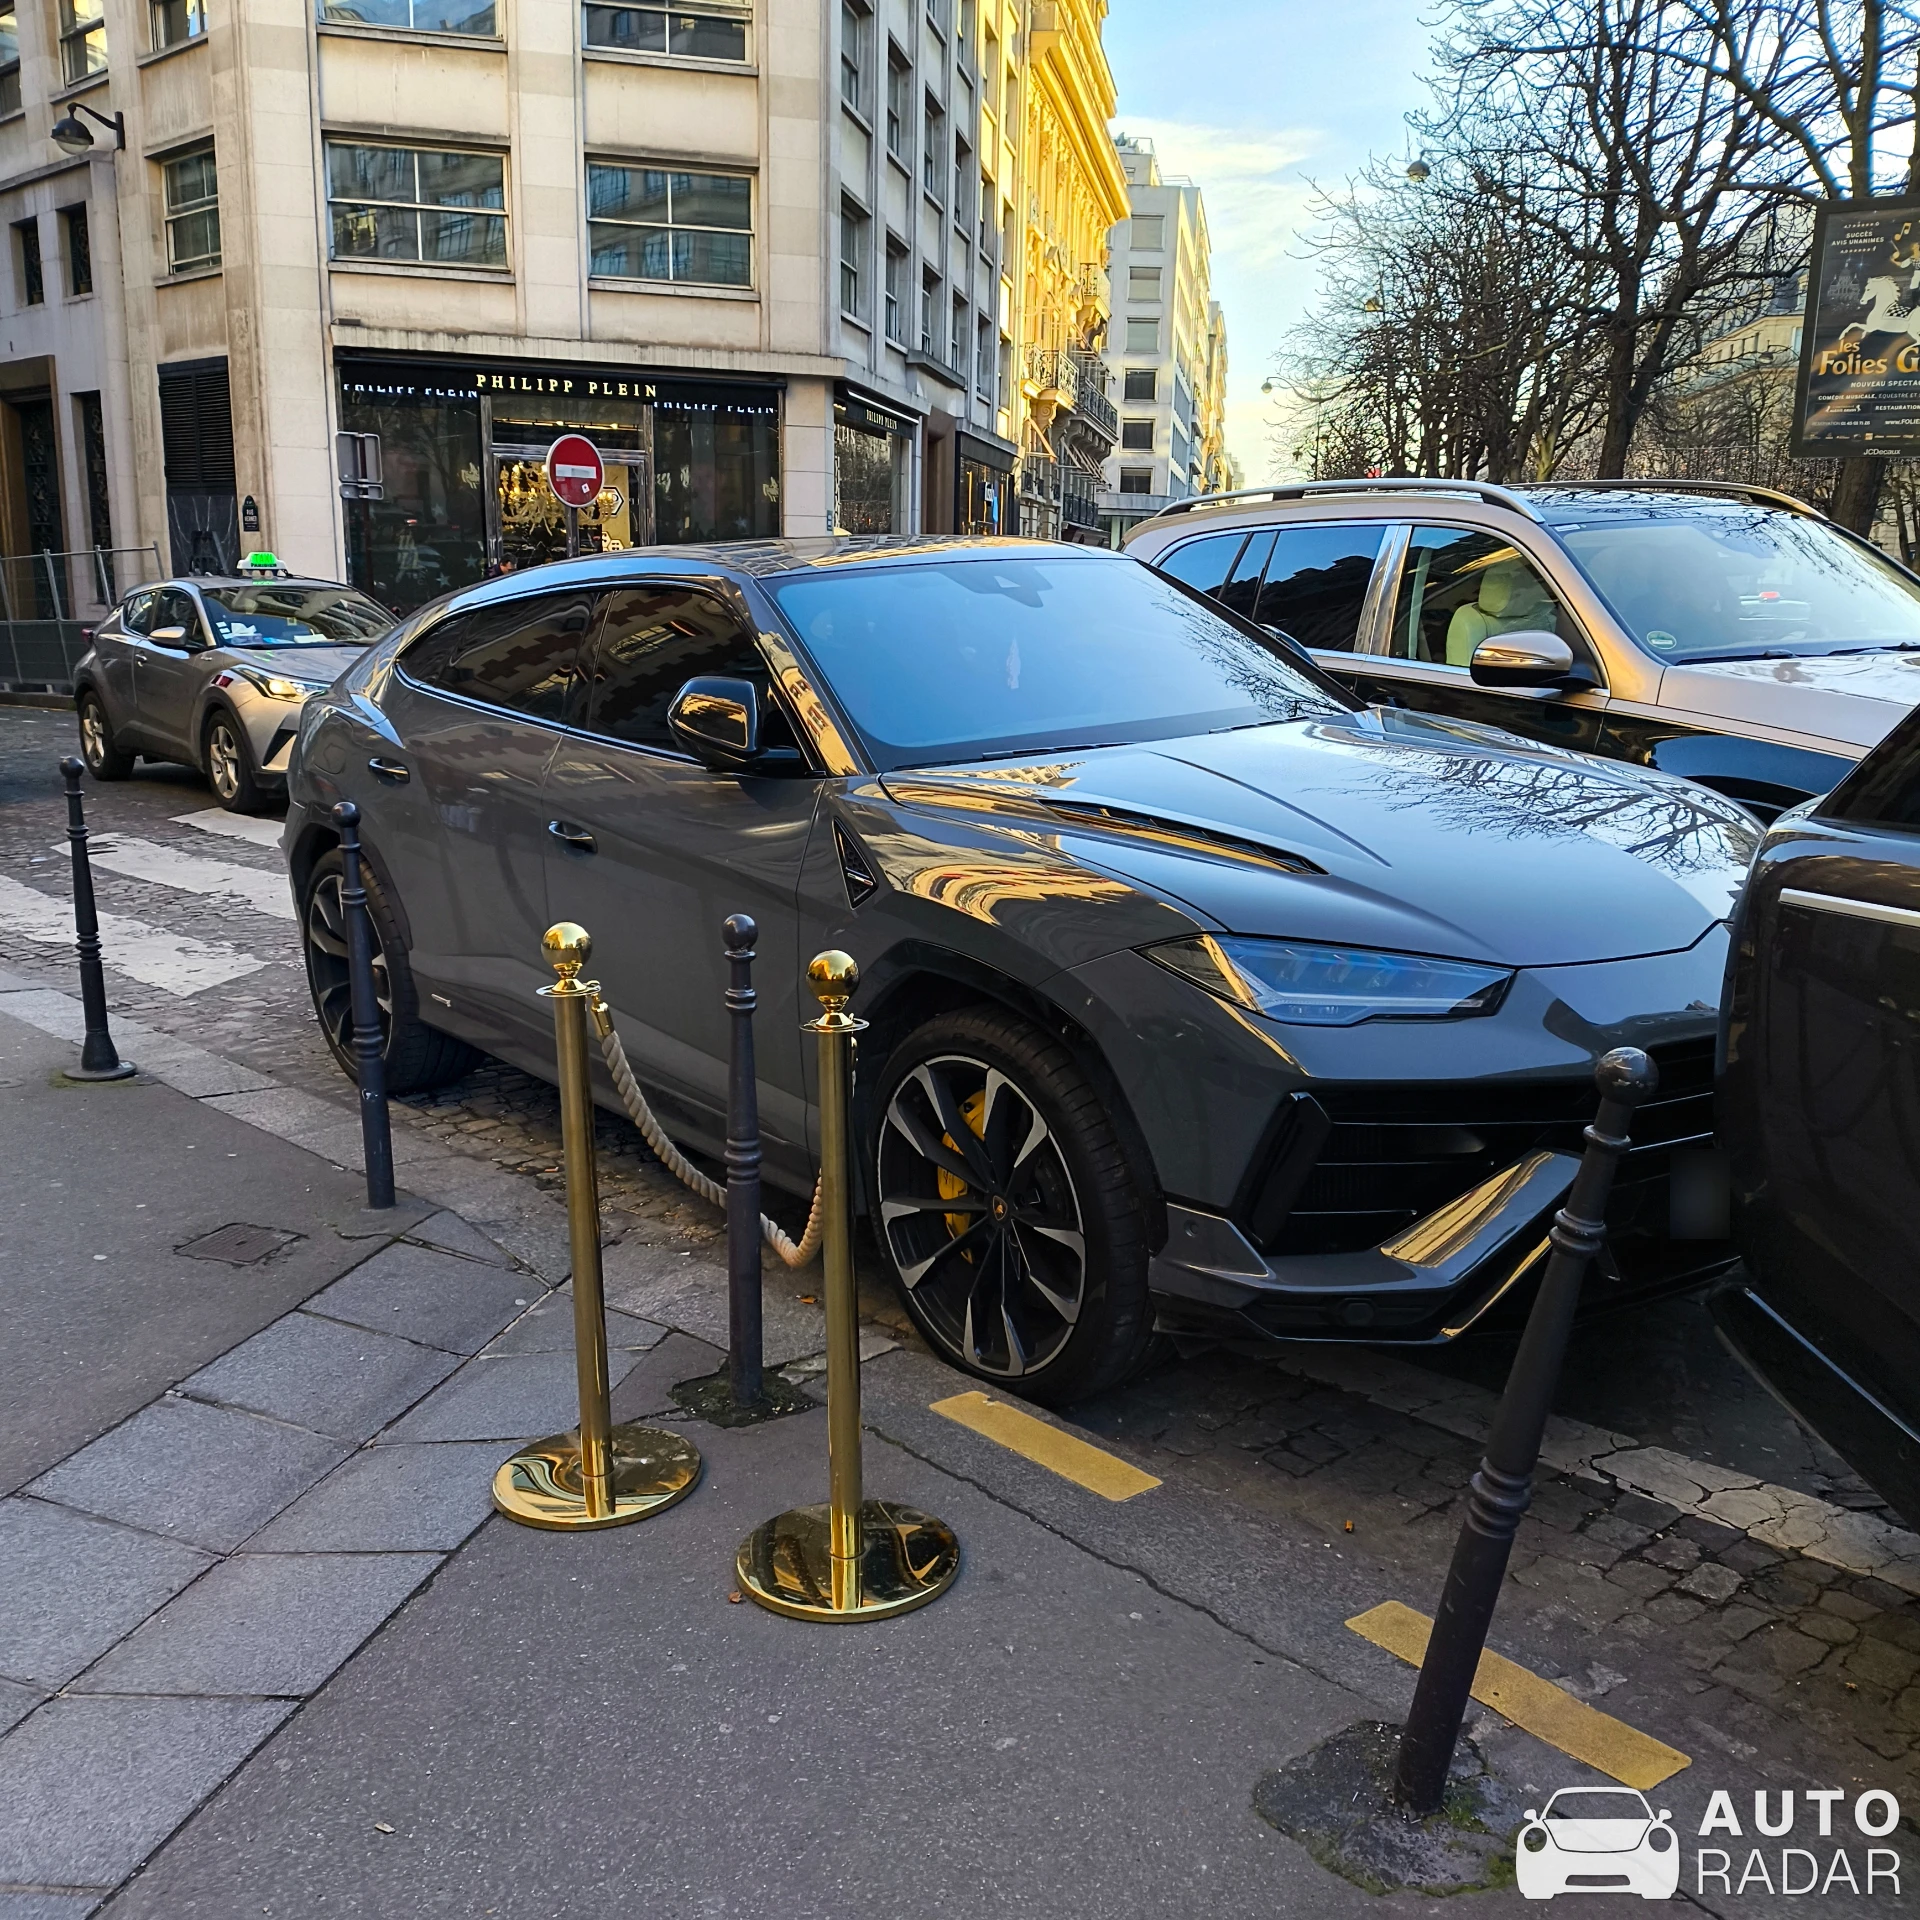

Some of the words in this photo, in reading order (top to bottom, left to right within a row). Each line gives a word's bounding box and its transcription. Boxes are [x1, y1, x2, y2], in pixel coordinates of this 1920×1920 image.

[1838, 339, 1860, 353] les
[1818, 350, 1888, 375] Folies
[476, 374, 573, 393] PHILIPP
[588, 381, 656, 397] PLEIN
